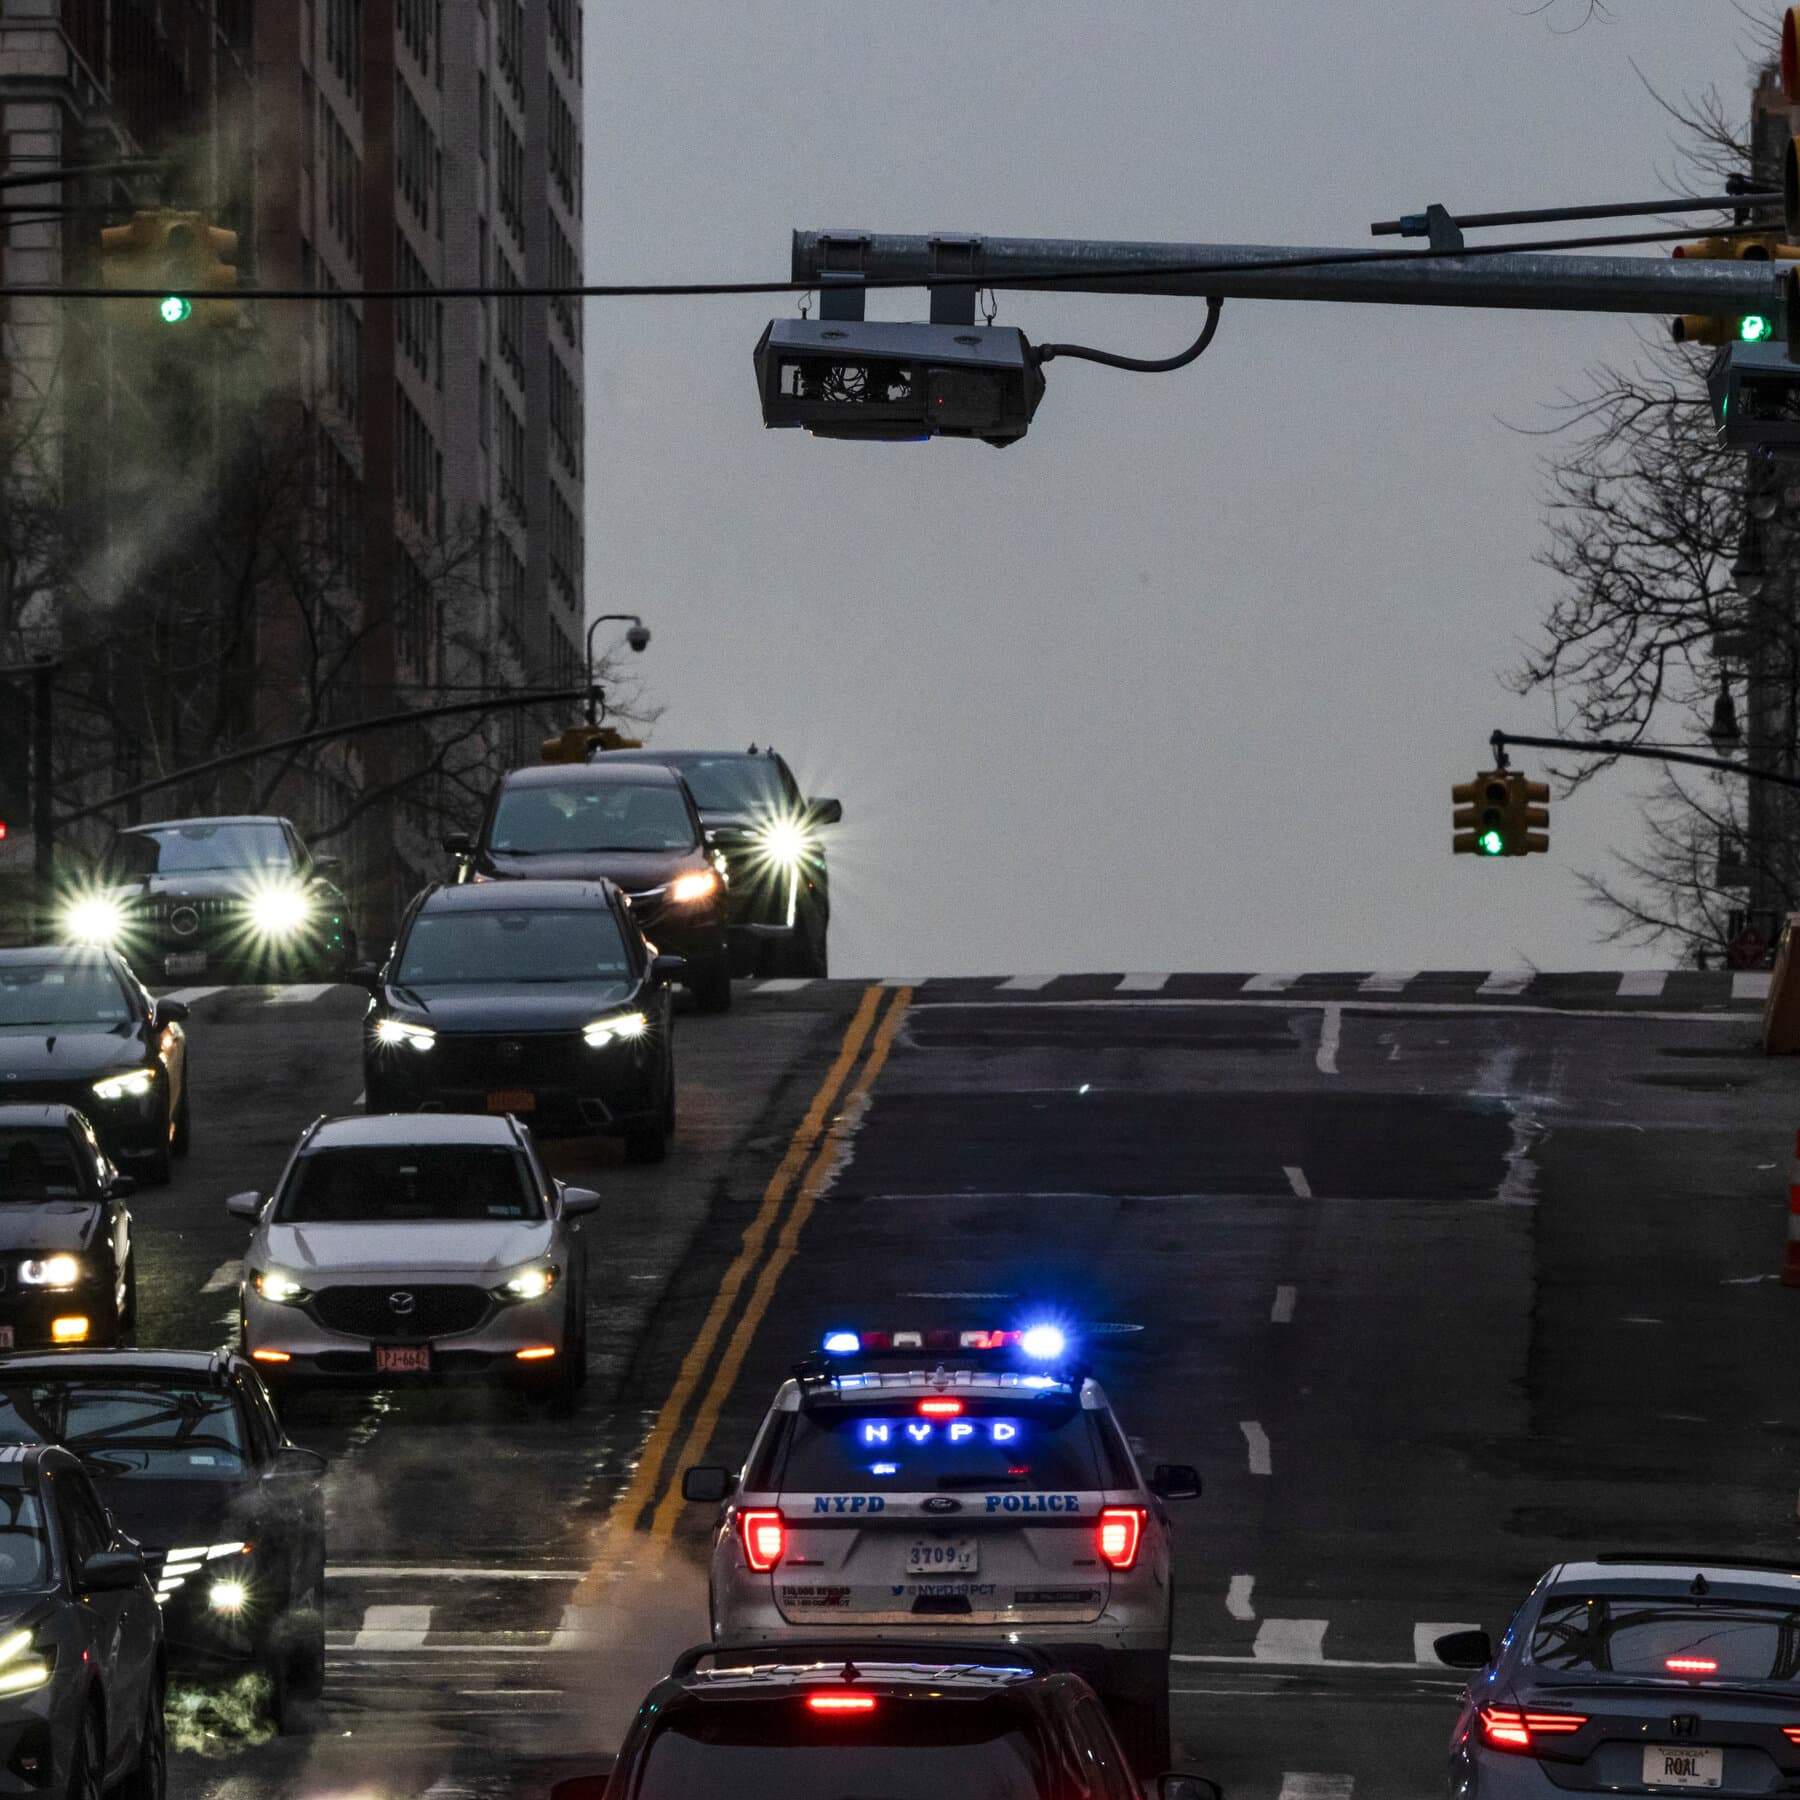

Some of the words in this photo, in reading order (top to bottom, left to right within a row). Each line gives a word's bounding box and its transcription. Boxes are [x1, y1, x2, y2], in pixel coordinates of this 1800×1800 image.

[865, 1423, 1016, 1441] NYPD
[813, 1496, 886, 1513] NYPD
[984, 1494, 1080, 1513] POLICE
[910, 1547, 957, 1565] 3709
